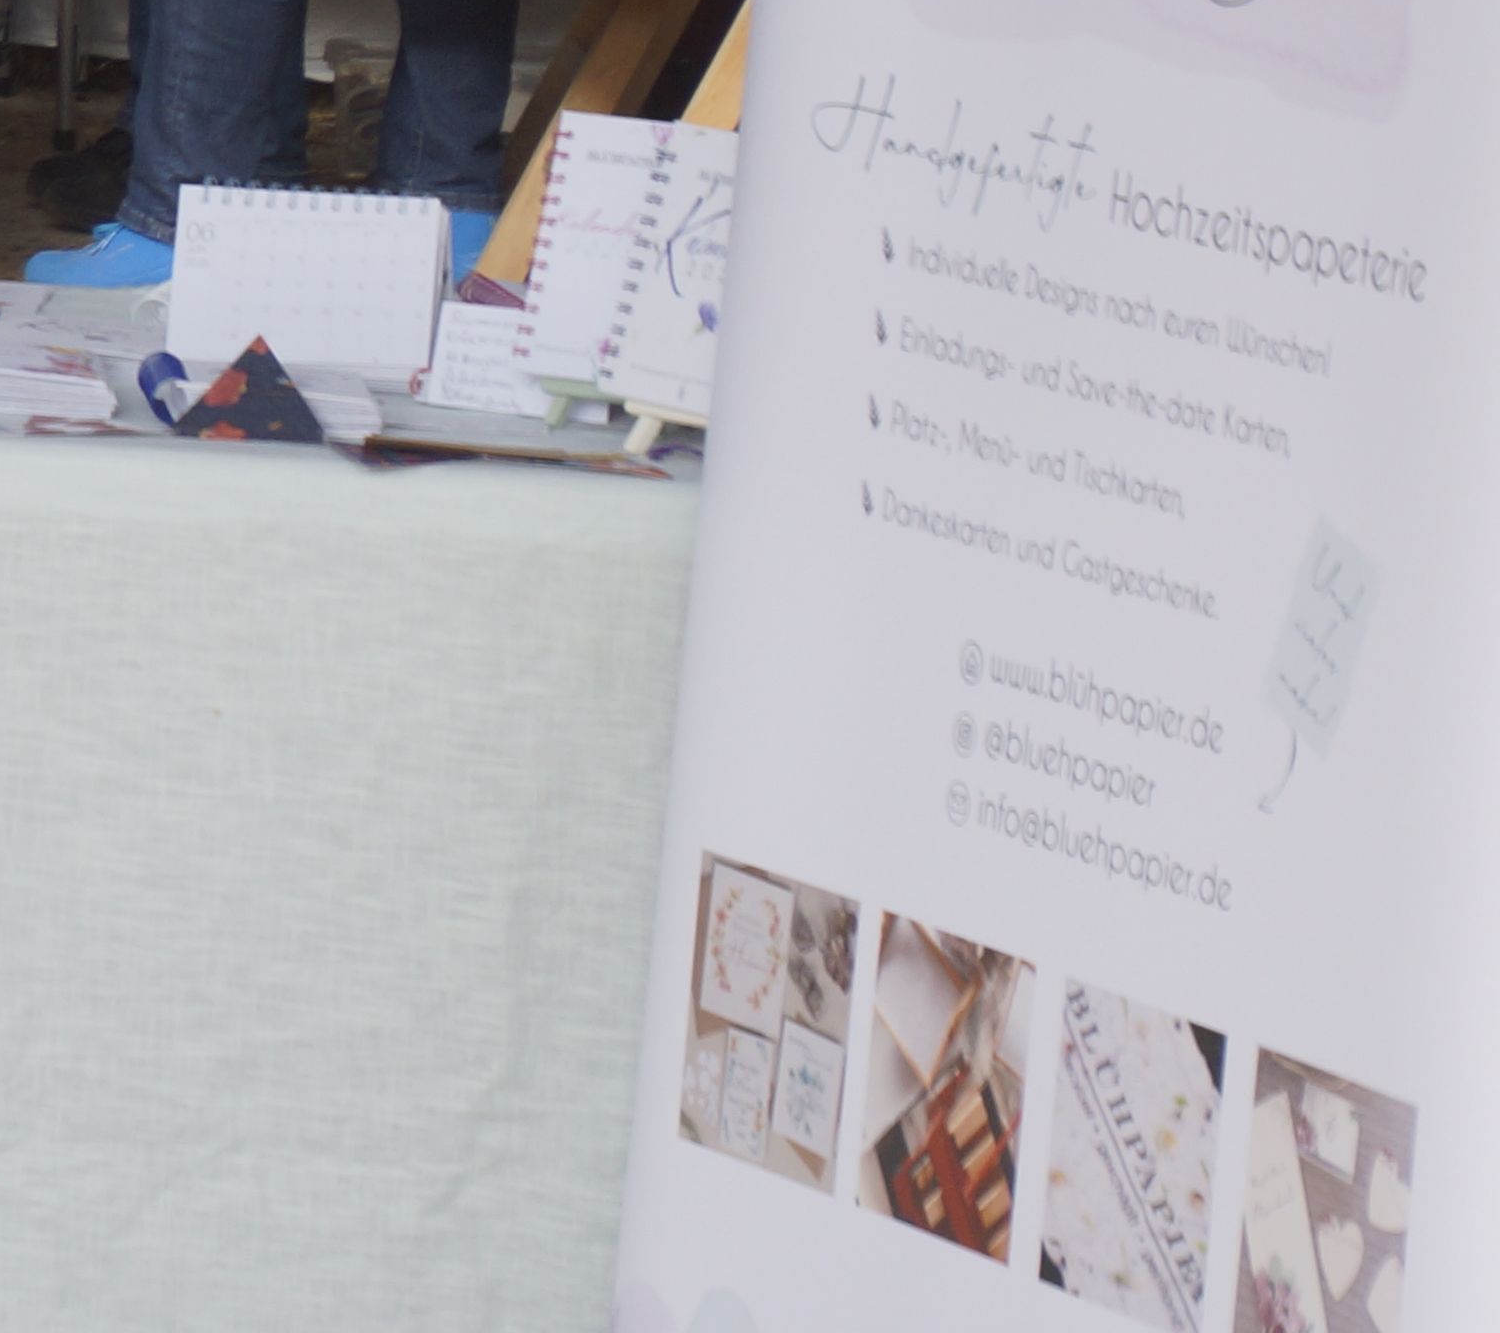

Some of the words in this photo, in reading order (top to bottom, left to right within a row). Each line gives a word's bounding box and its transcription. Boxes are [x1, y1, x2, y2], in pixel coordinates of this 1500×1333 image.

[906, 235, 1019, 295] Individuelle
[1024, 263, 1099, 317] Designs
[1103, 294, 1157, 331] nach
[1109, 167, 1427, 304] Hochzeitspapeterie
[1021, 356, 1061, 393] und
[1027, 449, 1067, 483] und
[881, 485, 1012, 557] Dankeskarten
[1016, 537, 1056, 571] und
[988, 655, 1226, 755] www.blühpapier.de
[984, 717, 1157, 808] @bluehpapier
[976, 789, 1234, 911] info@bluehpapier.de
[1064, 984, 1204, 1304] BLÜHPAPIE
